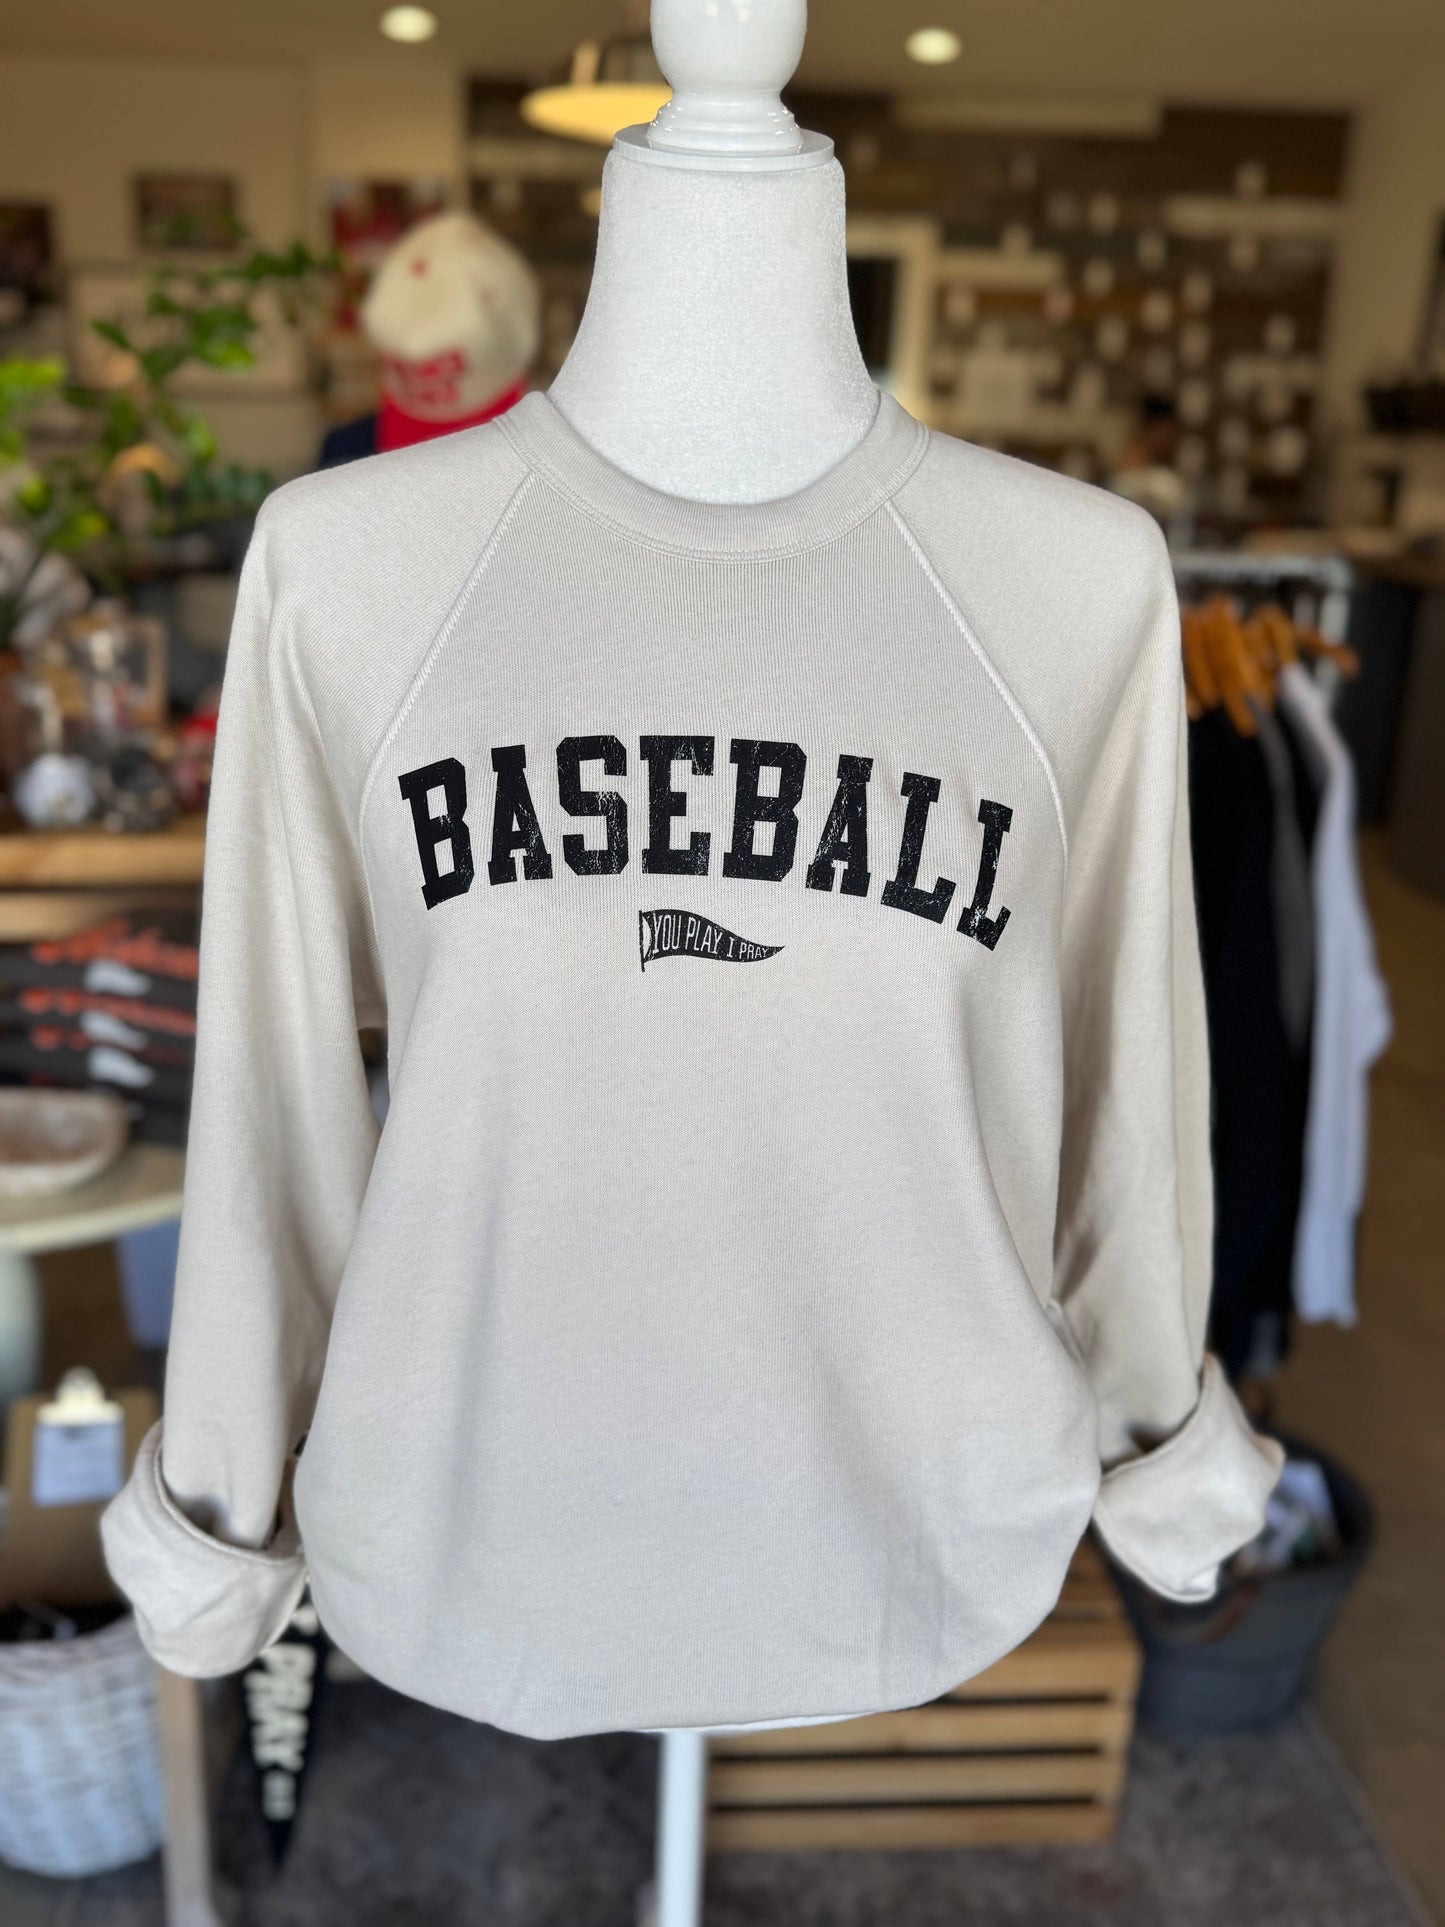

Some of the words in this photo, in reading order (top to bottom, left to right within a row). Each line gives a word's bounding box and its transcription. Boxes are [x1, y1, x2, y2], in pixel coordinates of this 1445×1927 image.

[398, 735, 1013, 952] BASEBALL
[652, 913, 682, 954] YOU
[685, 916, 722, 954] PLAY
[727, 936, 735, 958] I
[739, 942, 769, 959] PRAY
